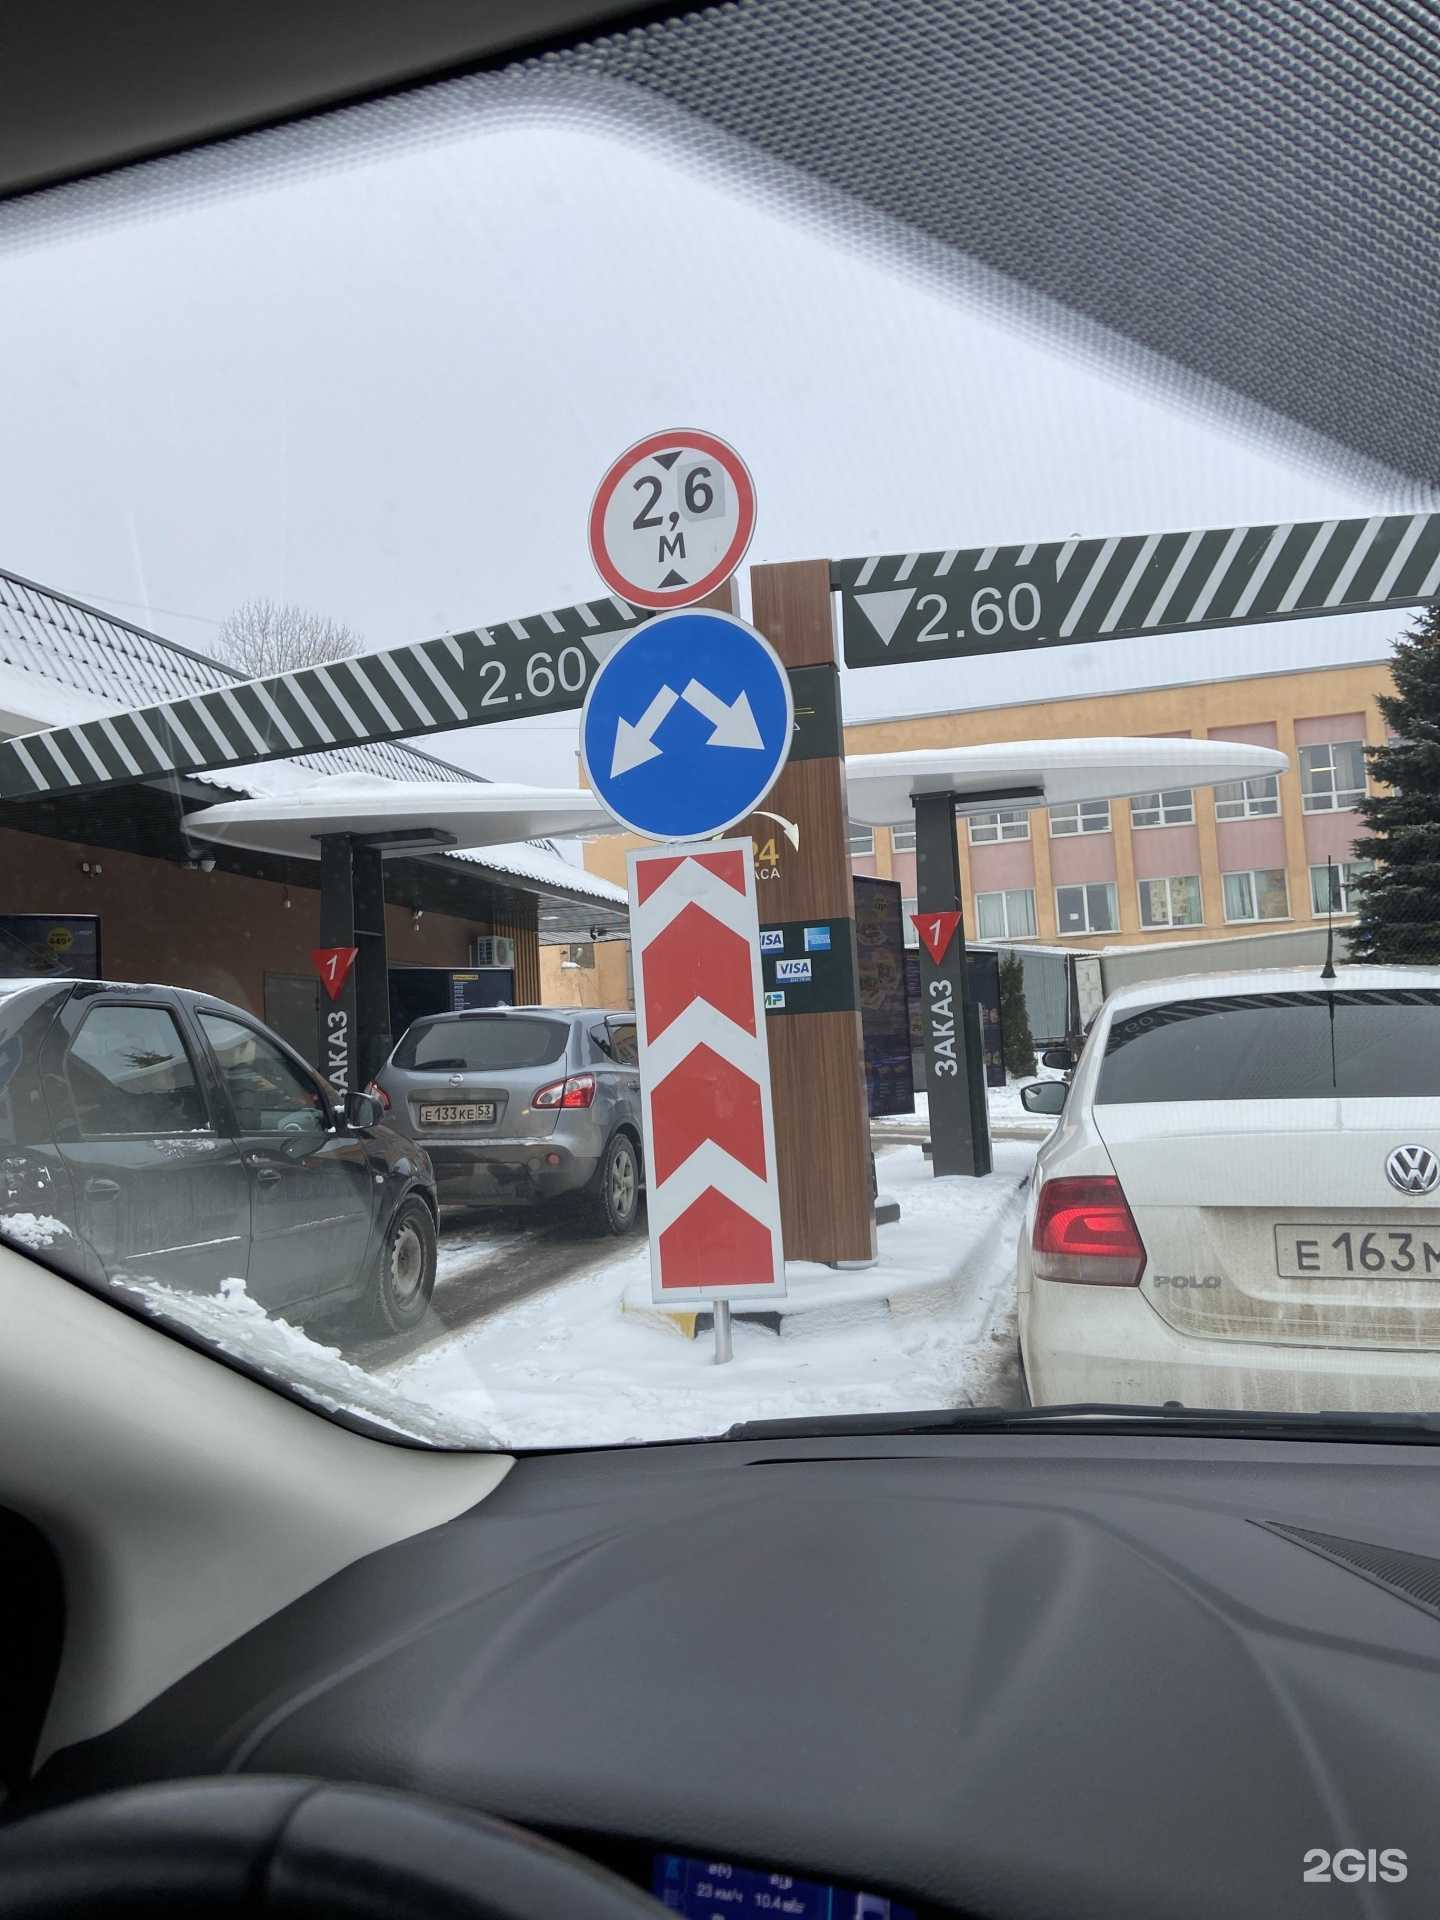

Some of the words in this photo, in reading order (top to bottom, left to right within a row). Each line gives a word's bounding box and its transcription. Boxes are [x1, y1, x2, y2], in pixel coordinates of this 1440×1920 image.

[633, 467, 713, 532] 2,6
[915, 582, 1041, 643] 2.60
[479, 646, 587, 706] 2.60
[761, 934, 781, 946] ISA
[929, 919, 941, 945] 1
[326, 954, 338, 980] 1
[780, 962, 810, 975] VISA
[929, 979, 957, 1077] ЗАКАЗ
[328, 1010, 348, 1098] АКАЗ
[1153, 1275, 1221, 1288] POLO
